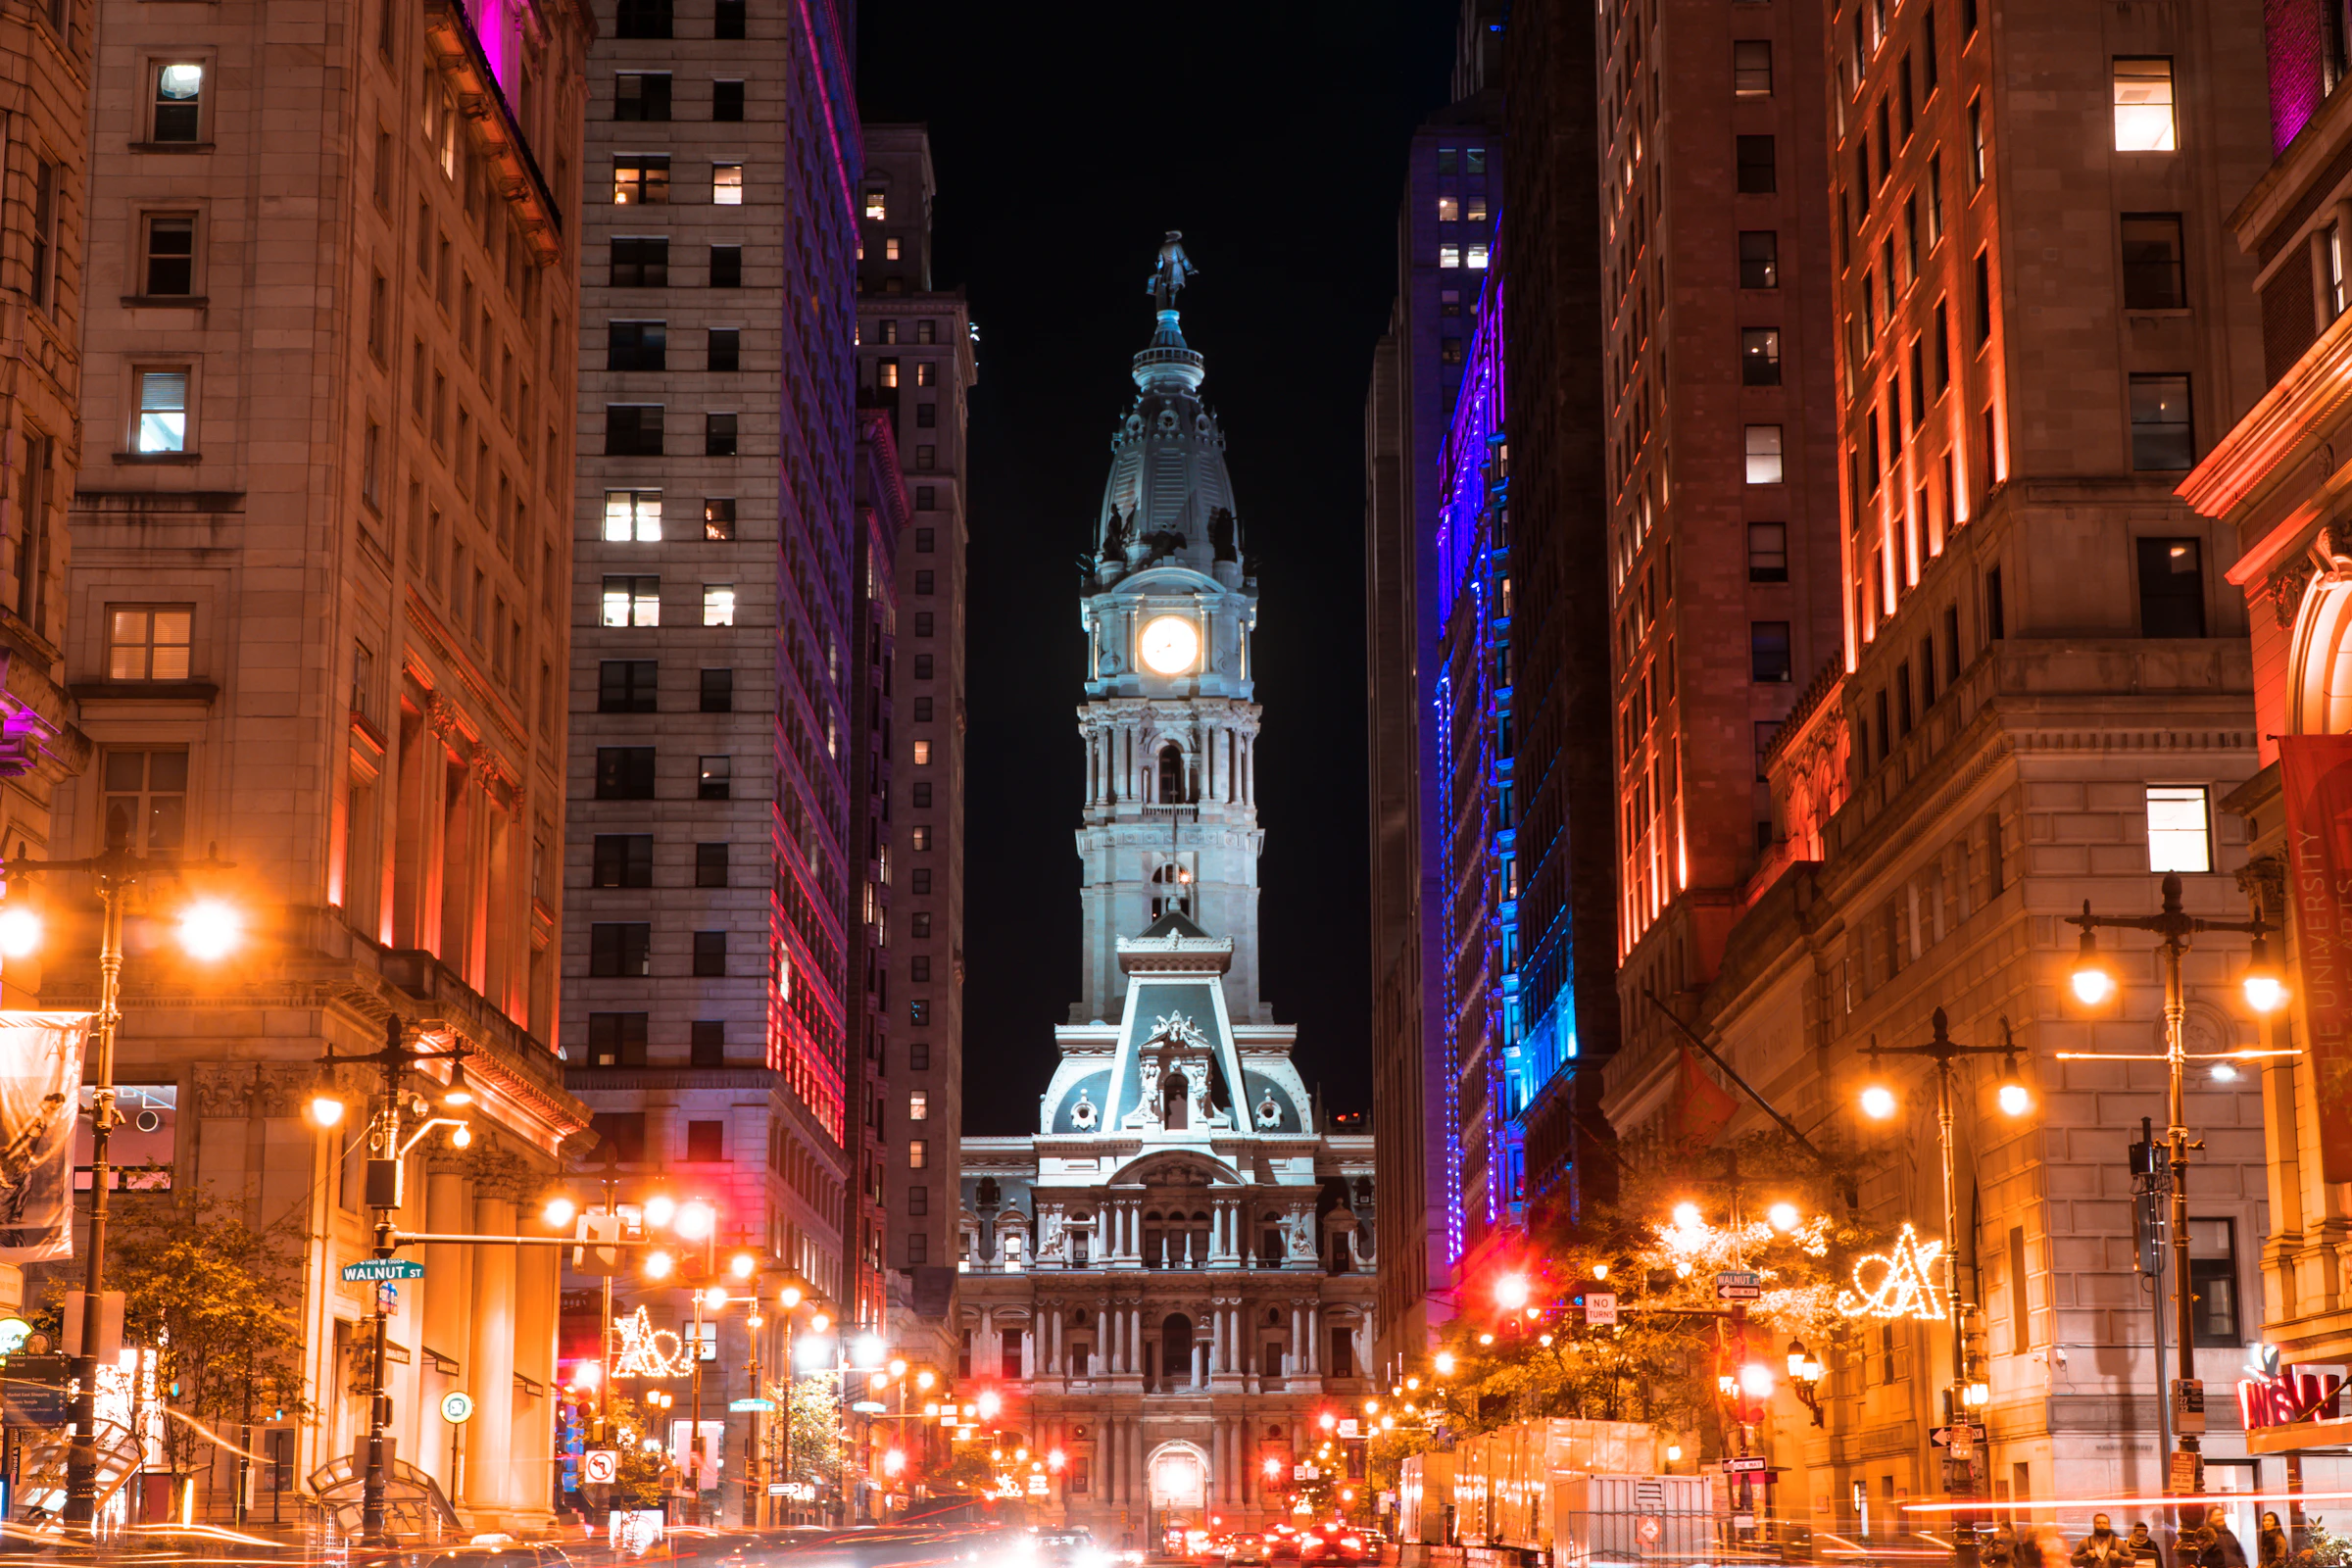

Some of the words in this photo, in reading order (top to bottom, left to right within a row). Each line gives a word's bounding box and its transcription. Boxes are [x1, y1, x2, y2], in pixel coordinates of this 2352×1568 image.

[2296, 829, 2338, 1007] UNIVERSITY
[344, 1266, 405, 1281] WALNUT
[410, 1268, 421, 1278] ST
[1717, 1275, 1751, 1285] WALNUT
[1593, 1298, 1609, 1307] NO
[1589, 1310, 1614, 1319] TURNS
[2179, 1388, 2184, 1396] 4
[2179, 1404, 2189, 1413] 32
